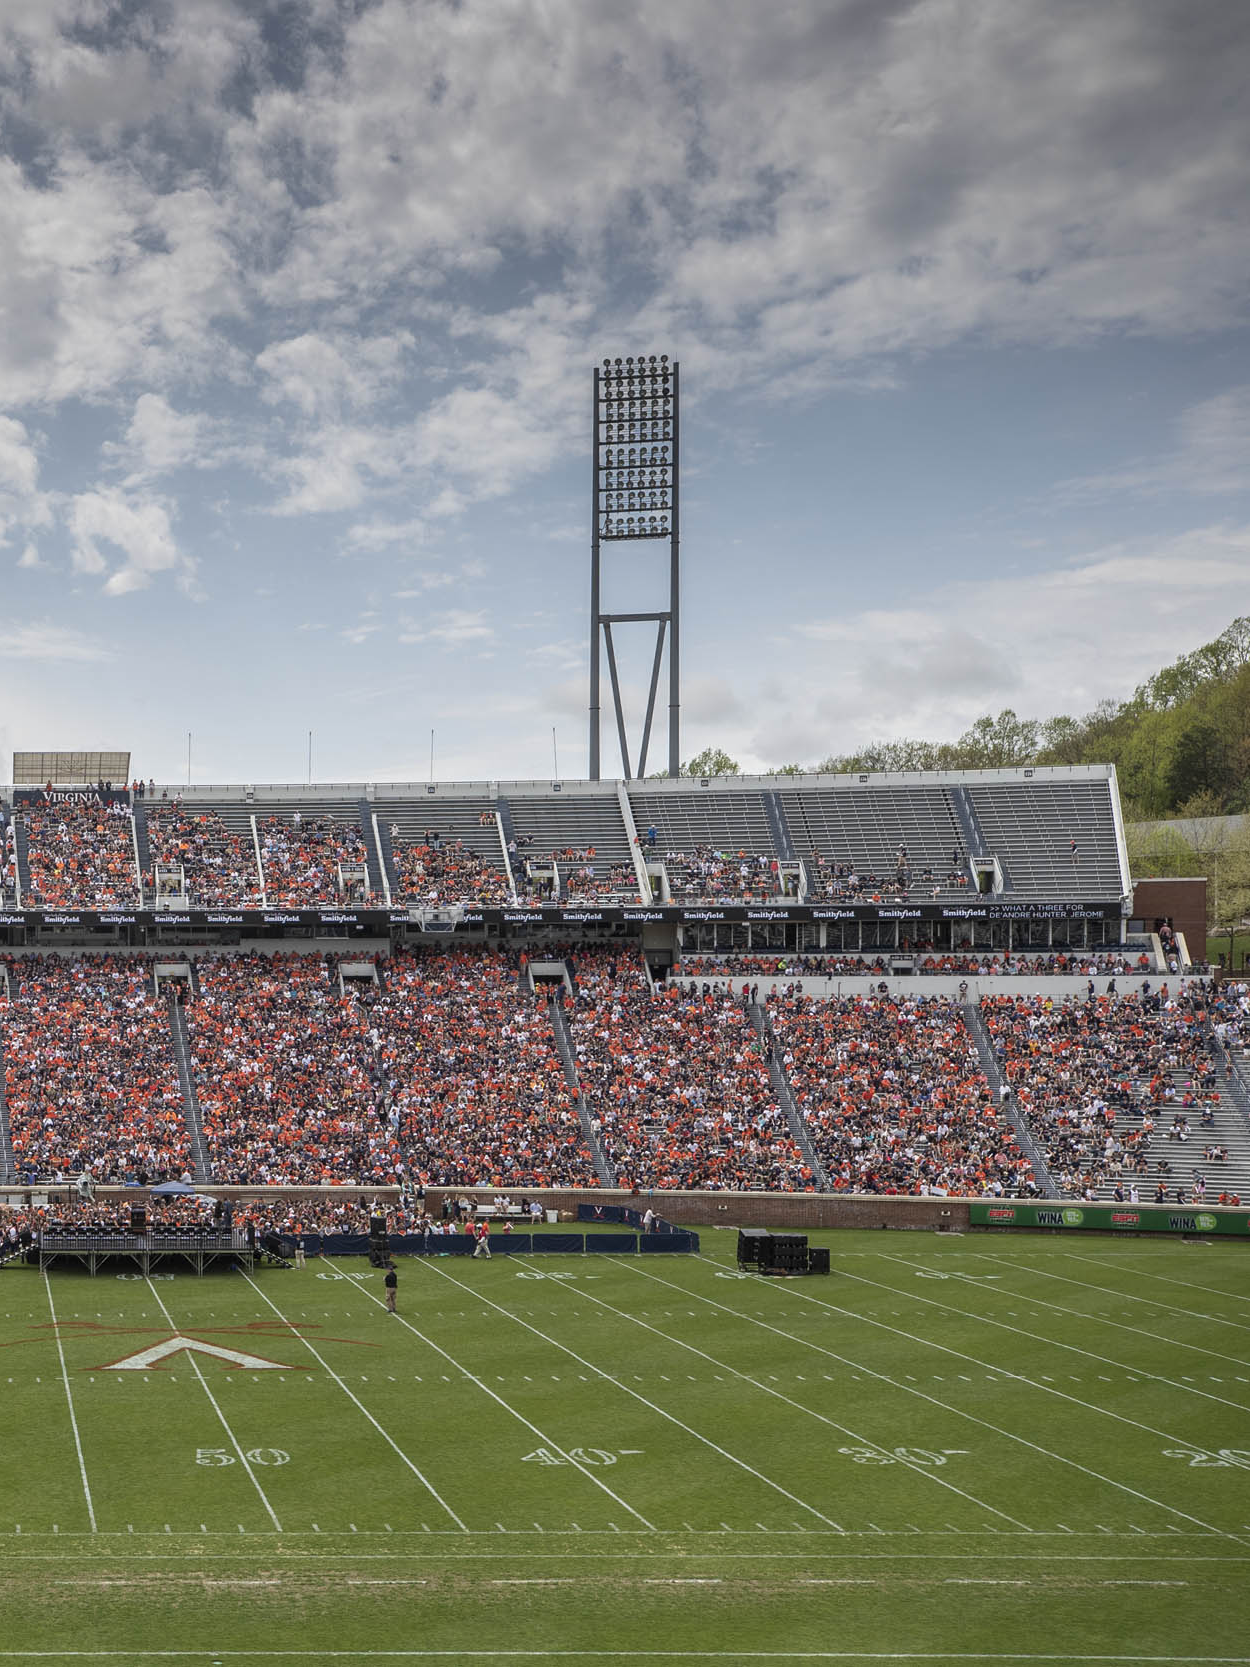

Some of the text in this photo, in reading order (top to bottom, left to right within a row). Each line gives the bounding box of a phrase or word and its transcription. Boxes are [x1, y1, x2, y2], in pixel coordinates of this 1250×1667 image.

[42, 791, 101, 803] VIRGINIA
[503, 912, 543, 923] Smithfield
[562, 911, 603, 922] Smithfield
[623, 910, 663, 921] Smithfield
[683, 910, 724, 921] Smithfield
[745, 909, 789, 920] Smithfield
[812, 909, 855, 920] Smithfield
[878, 908, 921, 919] Smithfield
[942, 907, 986, 918] Smithfield
[989, 911, 1031, 919] DE'ANDRE
[41, 914, 80, 925] Smithfield
[97, 914, 136, 925] Smithfield
[151, 913, 190, 924] Smithfield
[204, 913, 243, 924] Smithfield
[261, 913, 300, 924] Smithfield
[320, 913, 357, 924] Smithfield
[1037, 1212, 1064, 1224] WINA
[1169, 1216, 1197, 1229] WINA
[195, 1448, 291, 1467] 50
[520, 1447, 617, 1467] 40
[837, 1446, 949, 1466] 30
